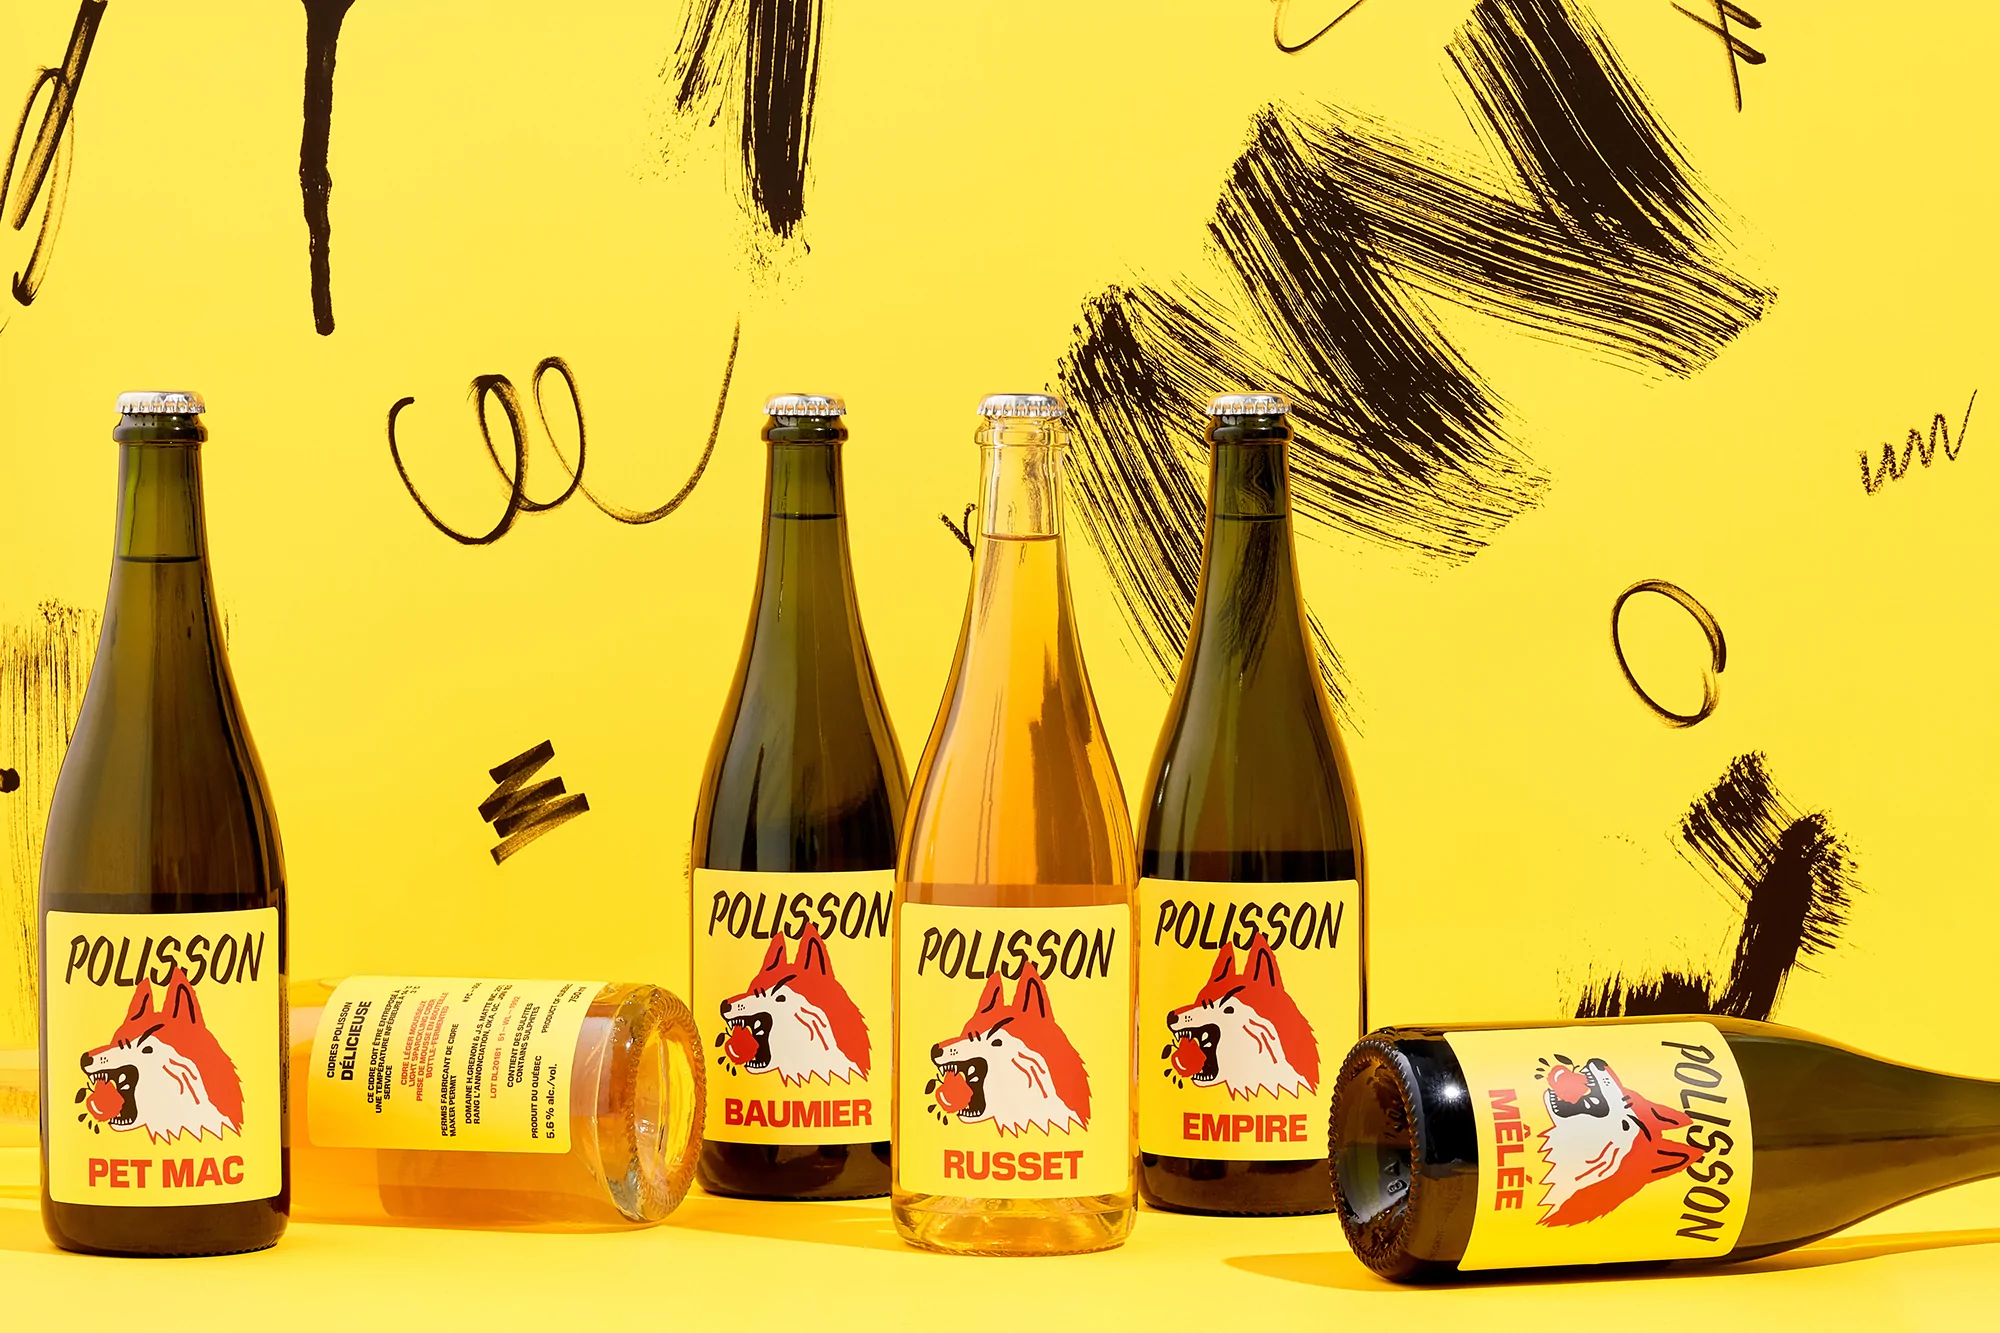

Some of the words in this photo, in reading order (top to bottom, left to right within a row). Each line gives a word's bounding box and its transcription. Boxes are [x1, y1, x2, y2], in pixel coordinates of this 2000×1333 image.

[708, 890, 893, 940] POLISSON
[1154, 900, 1344, 949] POLISSON
[65, 931, 265, 987] POLISSON
[917, 927, 1116, 980] POLISSON
[410, 999, 427, 1035] MOUSSEUX
[426, 1021, 434, 1033] EN
[479, 1000, 493, 1022] MATTE
[517, 1002, 534, 1032] SULFITES
[541, 1005, 557, 1034] PRODUCT
[327, 1042, 339, 1078] CIDRES
[333, 1001, 353, 1042] POLISSON
[339, 1000, 372, 1080] DÉLICIEUSE
[372, 1027, 384, 1046] ÊTRE
[448, 1023, 459, 1045] CIDRE
[477, 1023, 485, 1035] J.S.
[513, 1032, 522, 1047] DES
[516, 1042, 528, 1083] CONTAINS
[522, 1006, 540, 1042] SULPHITES
[370, 1046, 379, 1065] DOIT
[403, 1036, 414, 1060] LÉGER
[419, 1033, 430, 1065] MOUSSE
[446, 1045, 453, 1056] DE
[467, 1042, 478, 1084] H.GRENON
[367, 1067, 376, 1091] CIDRE
[376, 1036, 390, 1094] TEMPÉRATURE
[401, 1061, 409, 1085] CIDRE
[409, 1062, 417, 1087] LIGHT
[418, 1065, 425, 1077] DE
[441, 1057, 451, 1104] FABRICANT
[491, 1047, 502, 1085] DL20181
[507, 1047, 518, 1088] CONTIENT
[531, 1055, 542, 1088] QUÉBEC
[367, 1092, 374, 1103] CE
[384, 1065, 393, 1100] SERVICE
[416, 1077, 424, 1101] PRISE
[449, 1074, 457, 1108] PERMIT
[531, 1089, 538, 1101] DU
[547, 1063, 557, 1105] alc./vol.
[725, 1097, 872, 1128] BAUMIER
[1183, 1112, 1308, 1143] EMPIRE
[1488, 1089, 1532, 1211] MÊLÉE
[1661, 1041, 1734, 1242] POLISSON
[88, 1158, 153, 1189] PET
[162, 1155, 244, 1188] MAC
[944, 1149, 1084, 1181] RUSSET
